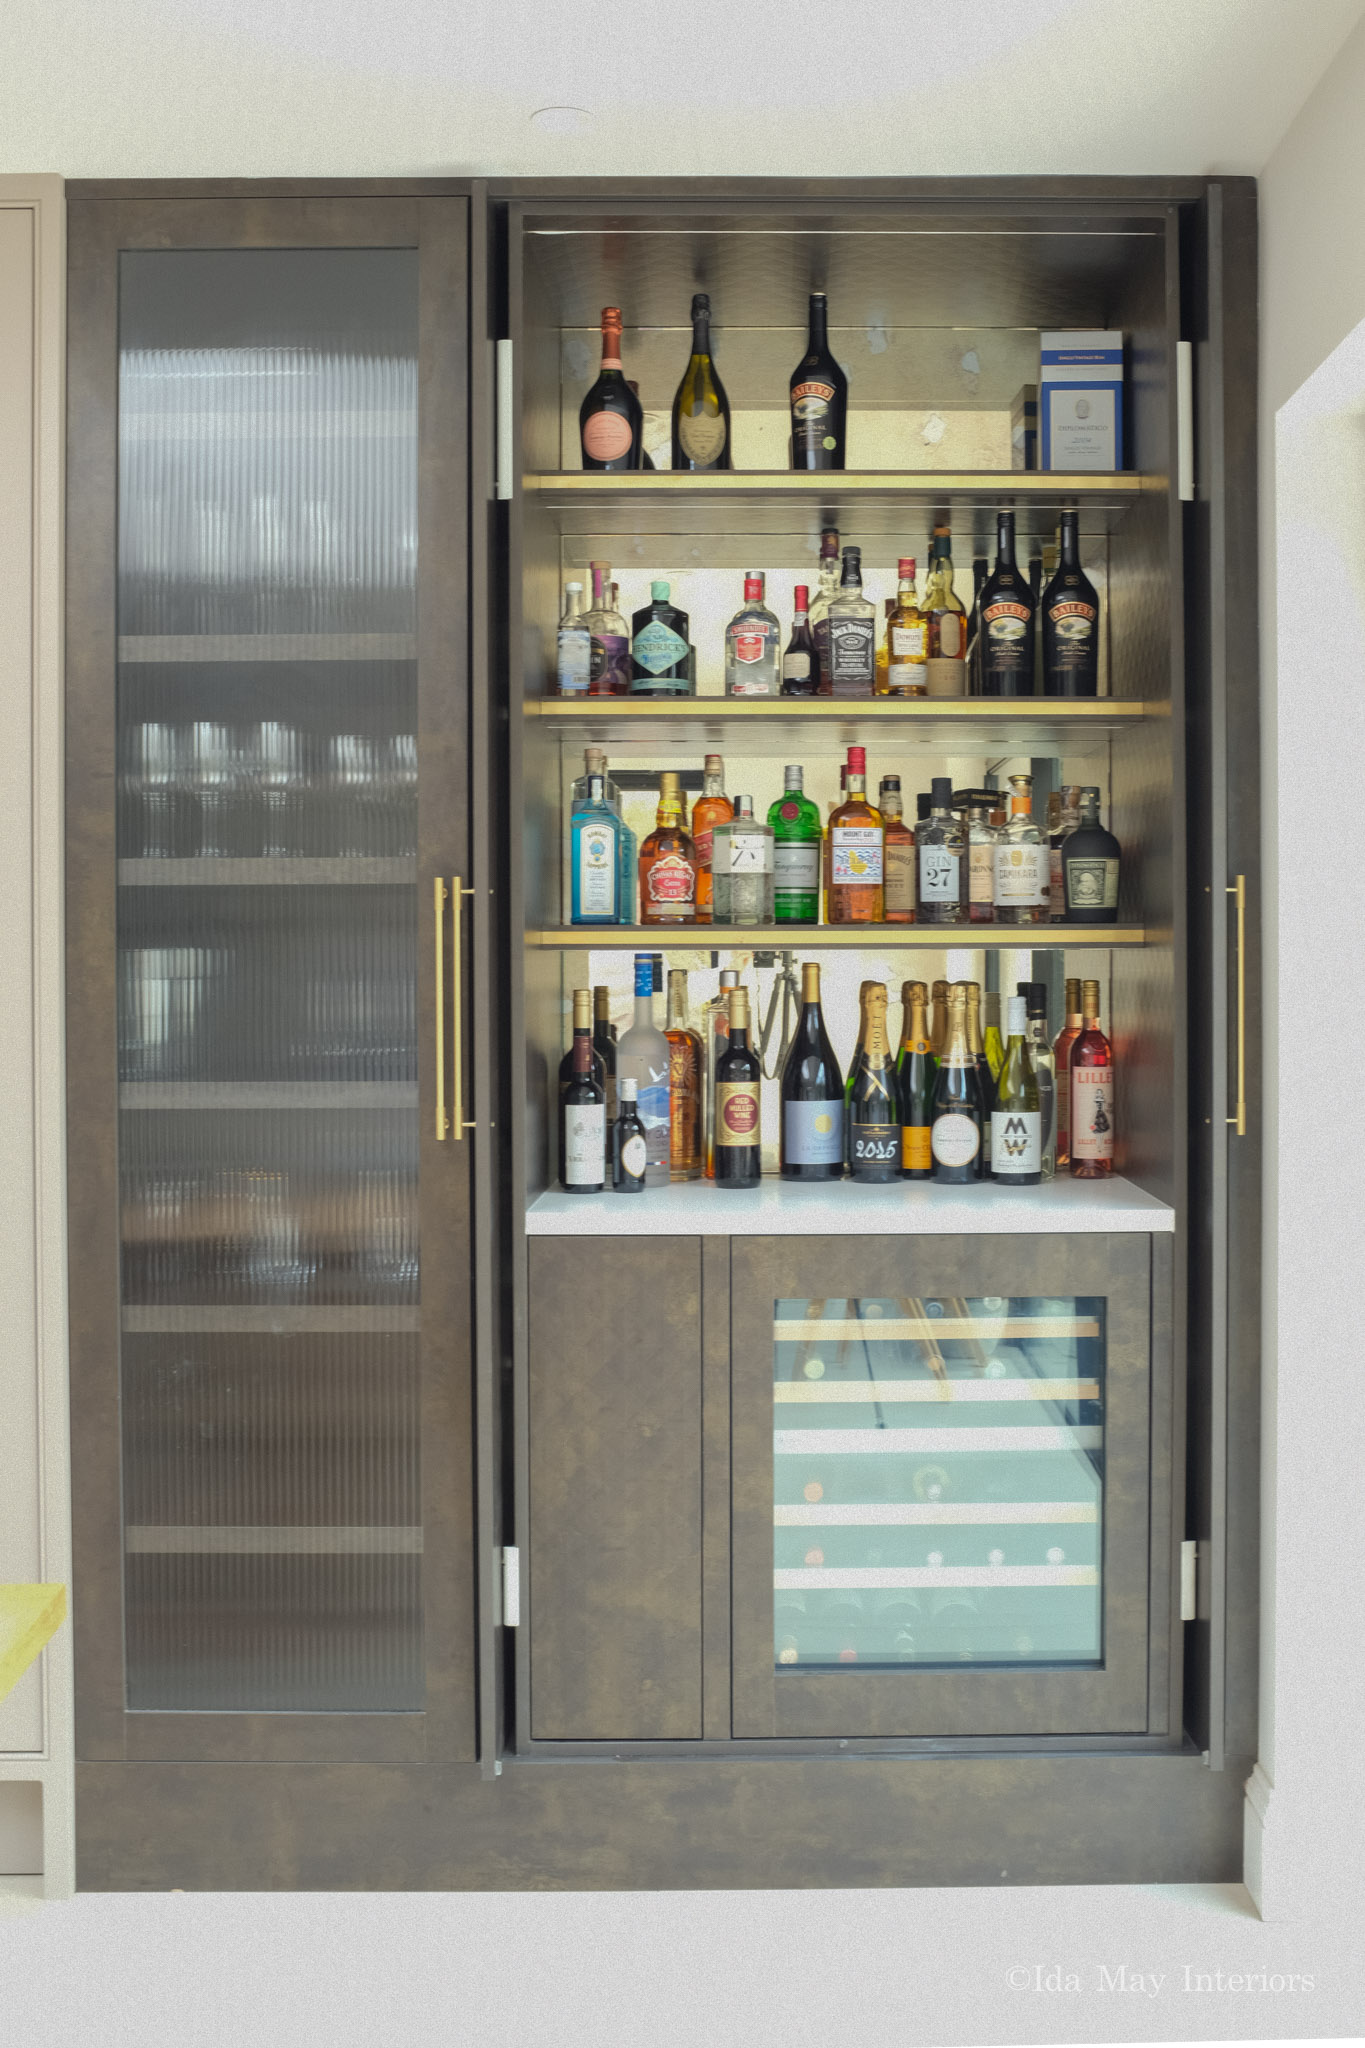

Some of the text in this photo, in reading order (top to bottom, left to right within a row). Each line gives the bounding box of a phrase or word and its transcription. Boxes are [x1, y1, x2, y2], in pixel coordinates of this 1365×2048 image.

[987, 605, 1028, 618] BAILEYS
[1053, 605, 1093, 617] BAILEYS
[926, 856, 952, 868] GIN
[927, 868, 953, 888] 27
[856, 1140, 898, 1159] 2015
